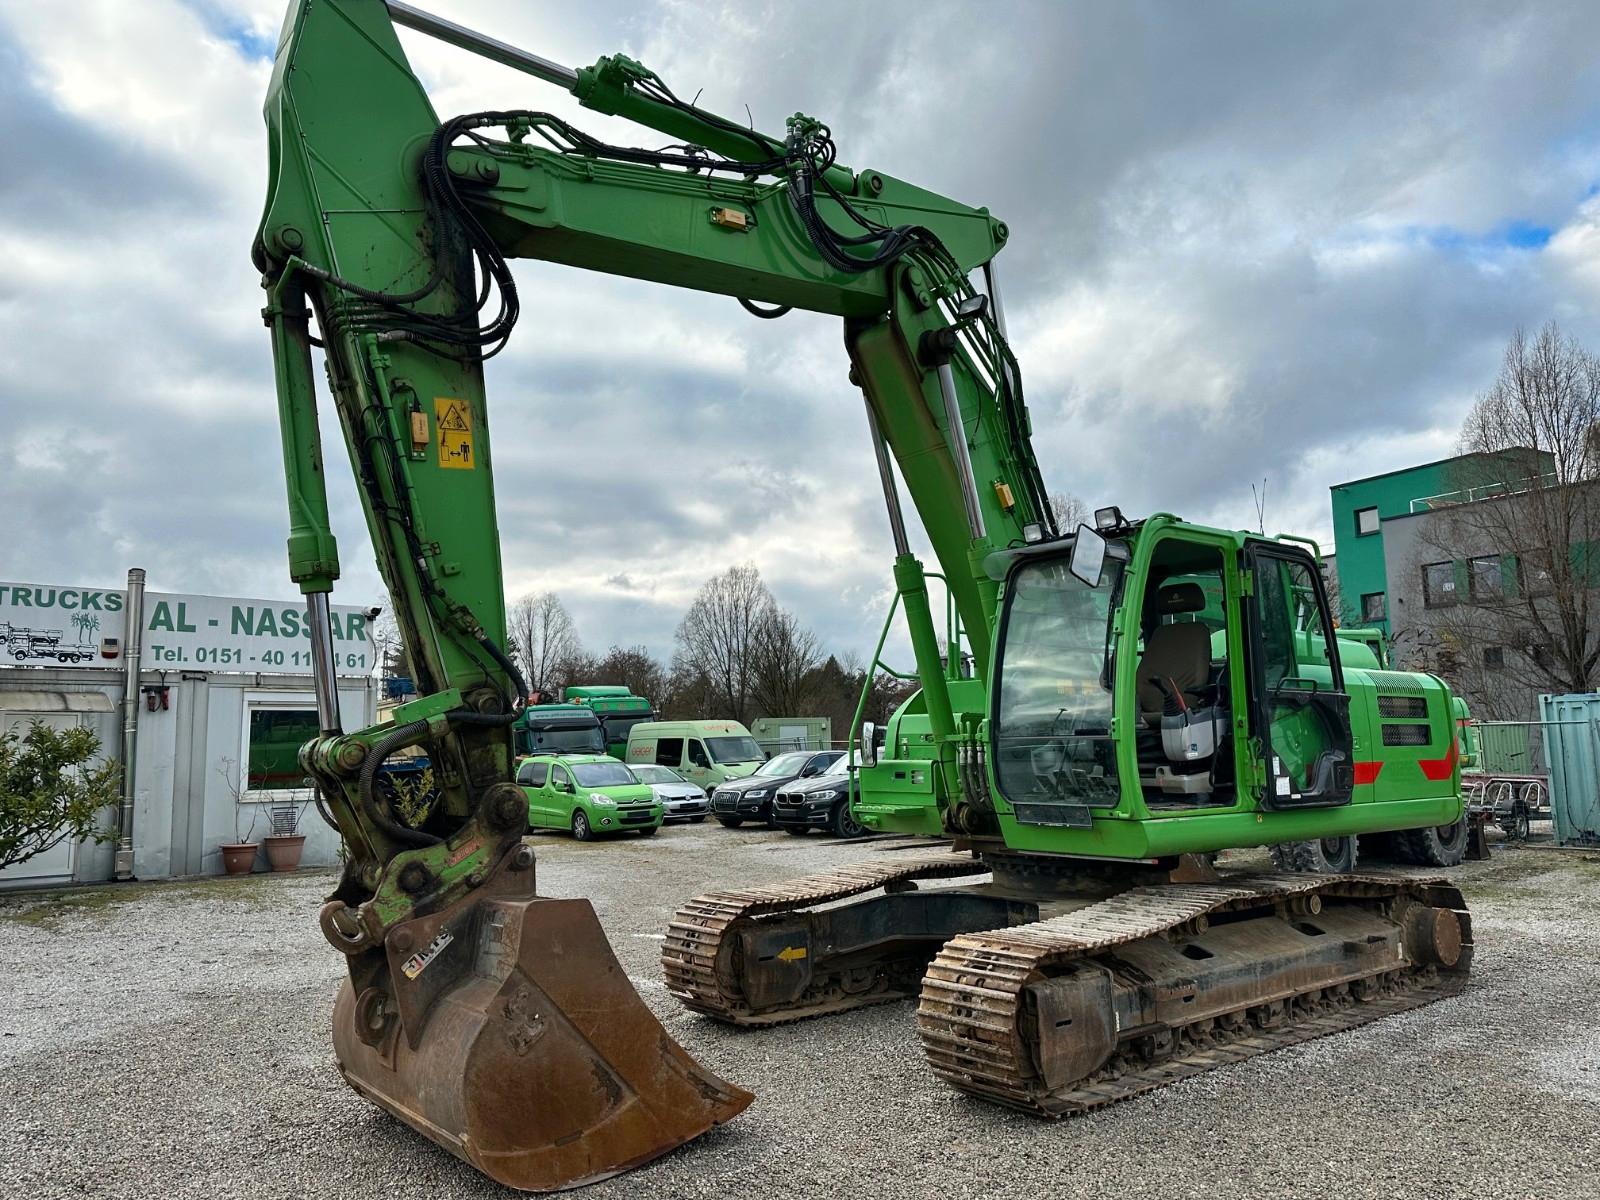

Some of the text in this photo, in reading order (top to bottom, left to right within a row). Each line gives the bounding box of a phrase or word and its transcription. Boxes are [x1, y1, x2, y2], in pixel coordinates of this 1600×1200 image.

[149, 601, 197, 632] AL
[152, 645, 188, 663] Tel.
[196, 646, 242, 664] 0151
[262, 649, 285, 666] 40
[291, 651, 311, 667] 11
[346, 653, 366, 669] 61
